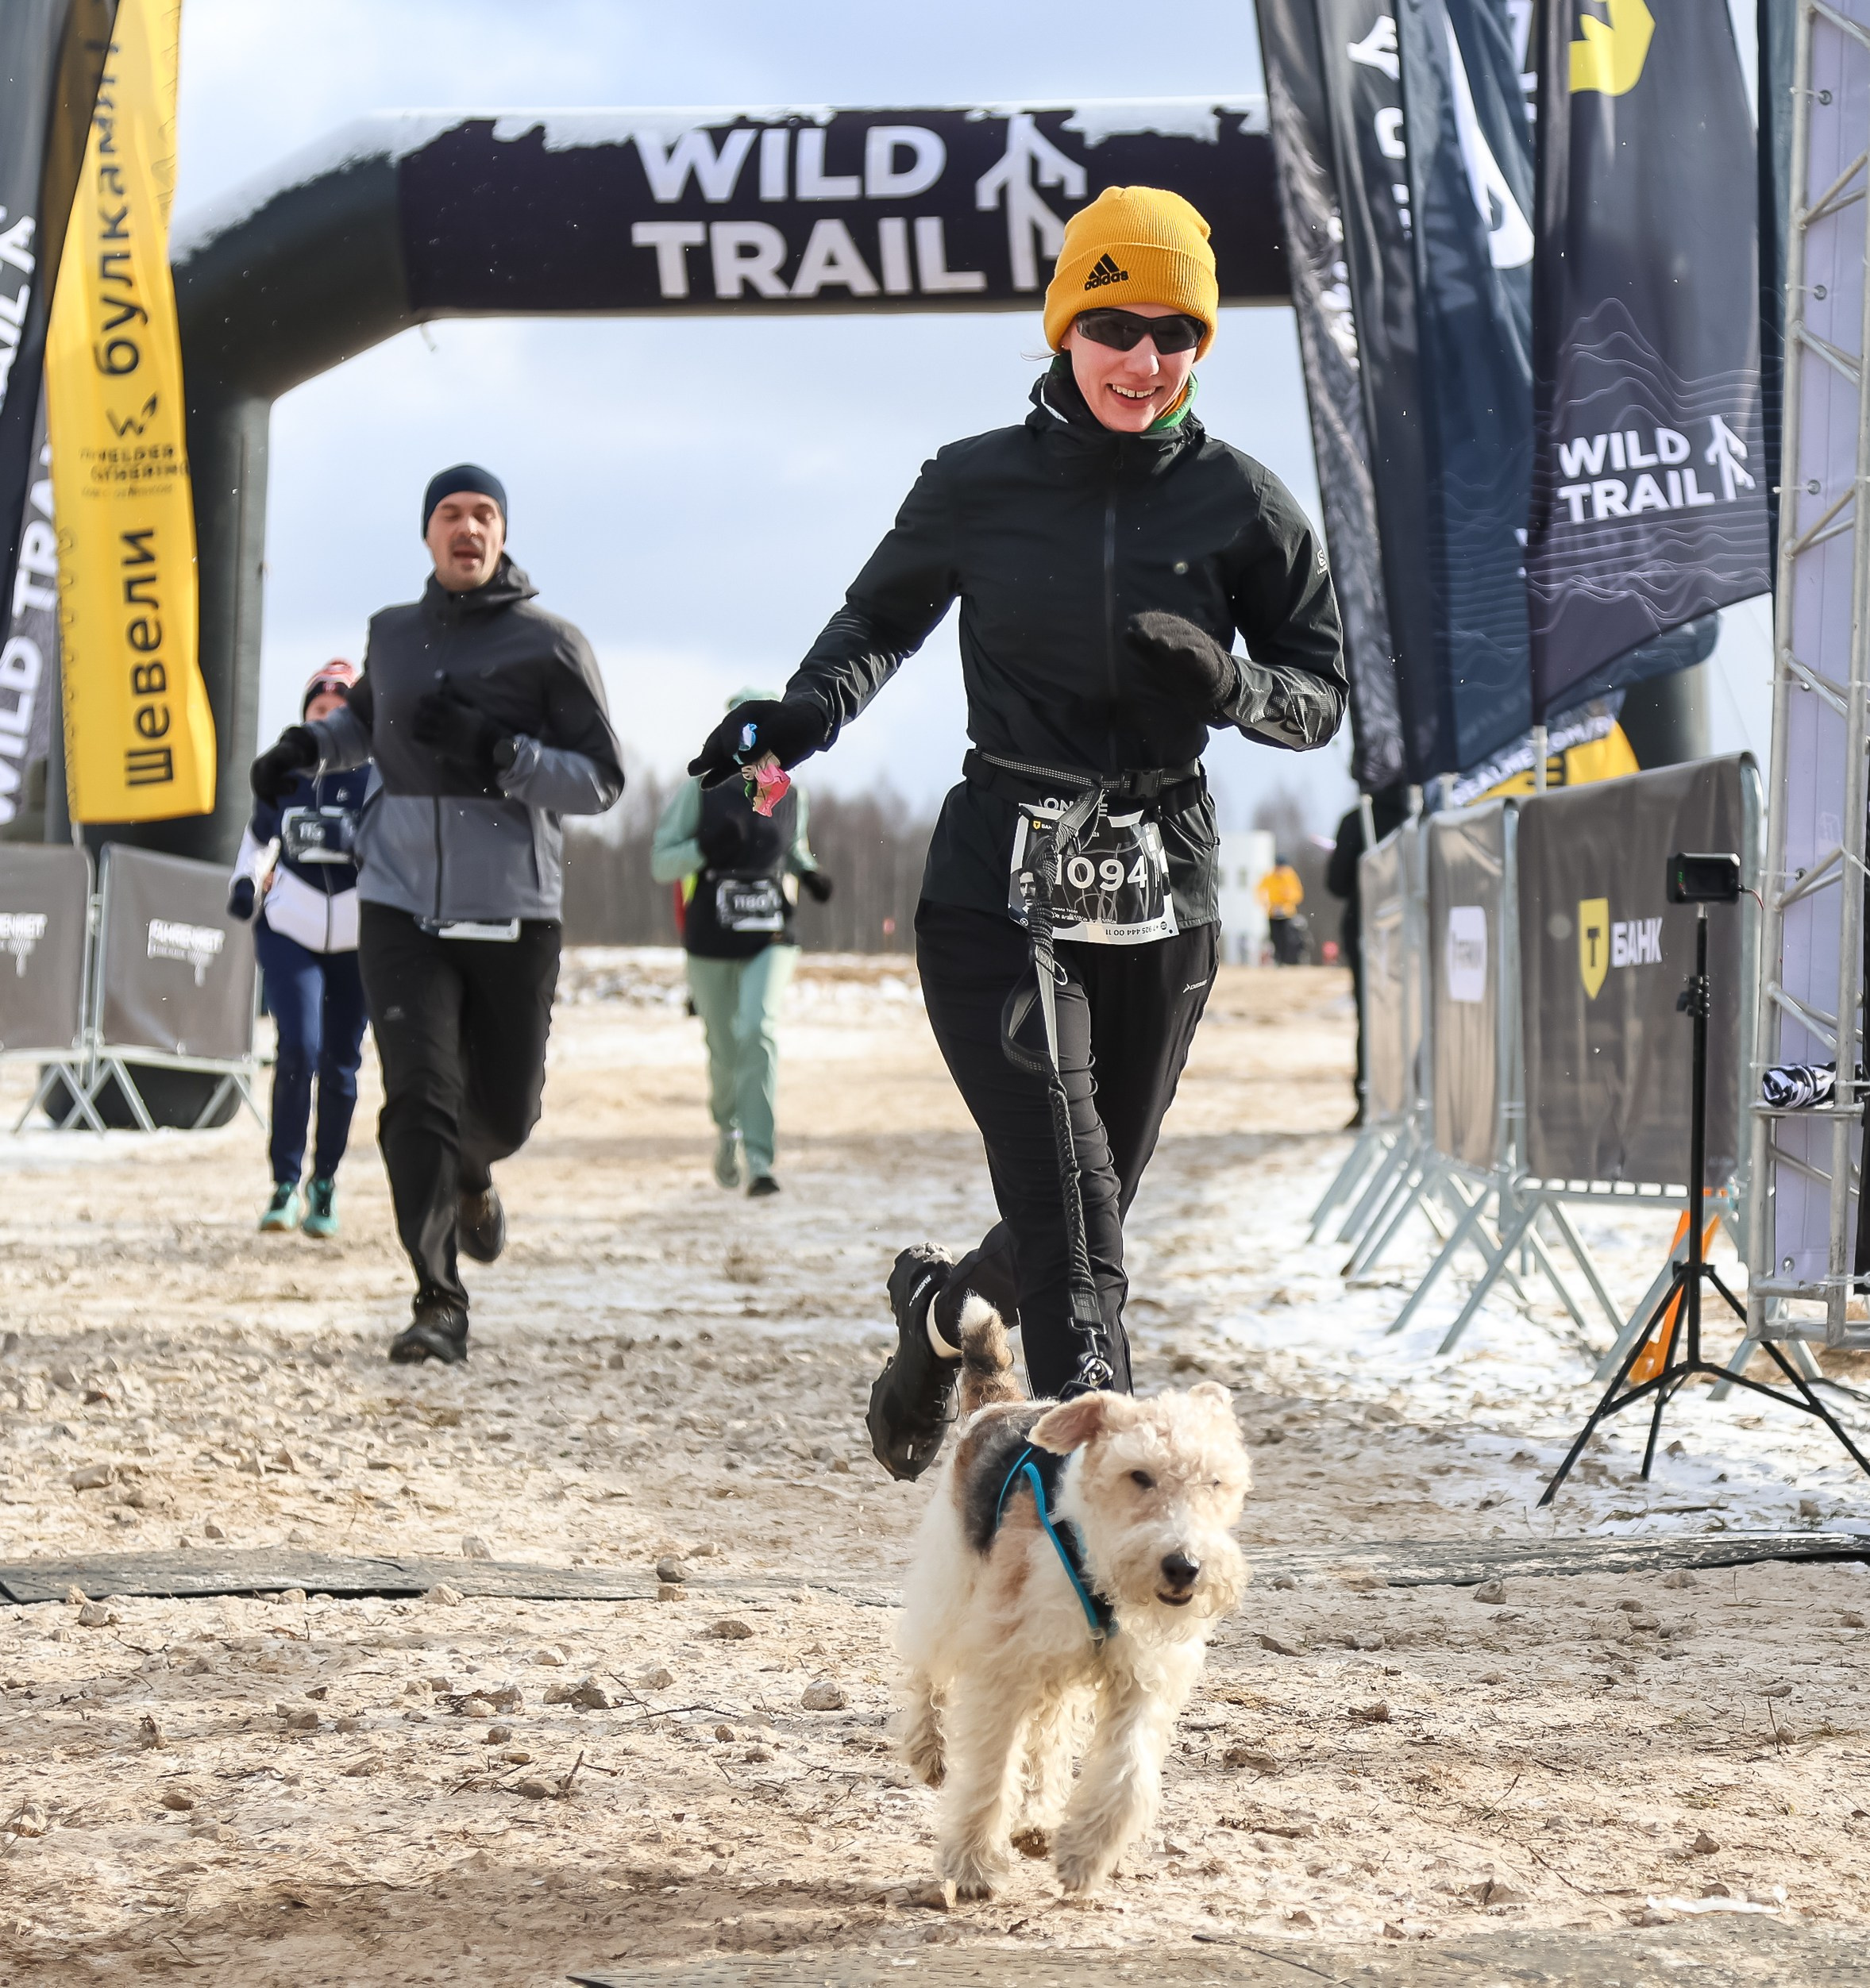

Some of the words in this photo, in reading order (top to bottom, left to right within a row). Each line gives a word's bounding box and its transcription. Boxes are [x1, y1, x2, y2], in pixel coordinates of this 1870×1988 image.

[634, 125, 947, 203] WILD
[631, 216, 987, 299] TRAIL
[1083, 270, 1129, 291] adidas
[1558, 427, 1691, 479] WILD
[1556, 468, 1716, 525] TRAIL
[121, 527, 174, 788] Шевели
[1054, 853, 1148, 892] 1094
[1611, 915, 1664, 969] БАНК
